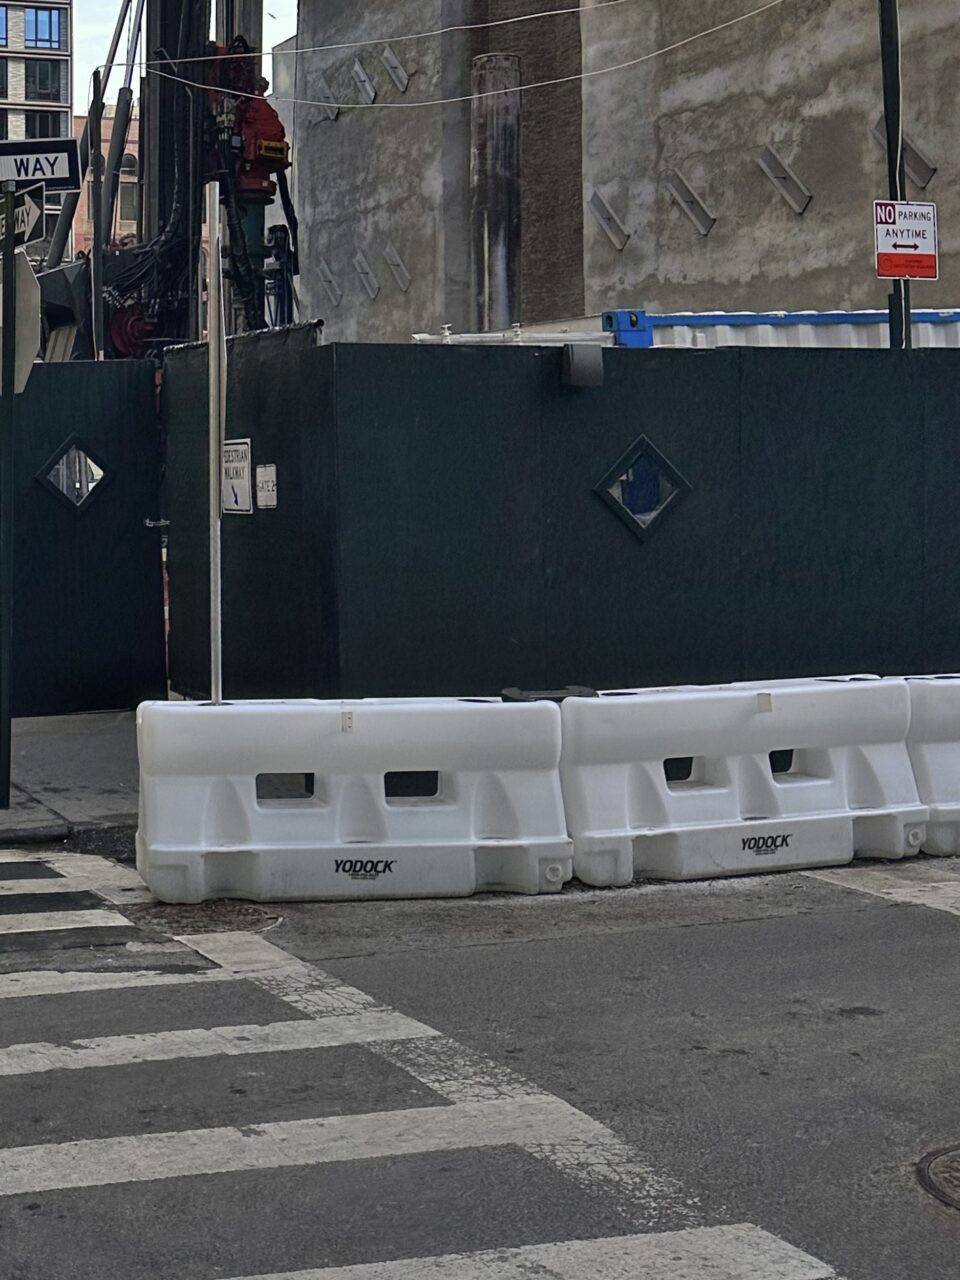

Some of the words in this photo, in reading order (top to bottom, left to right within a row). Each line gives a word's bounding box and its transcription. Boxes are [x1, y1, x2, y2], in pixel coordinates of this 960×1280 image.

[14, 156, 59, 177] WAY
[877, 205, 894, 223] NO
[898, 210, 932, 221] PARKING
[885, 229, 928, 239] ANYTIME
[223, 448, 248, 463] EDESTRIAN
[742, 834, 790, 851] YODOCK
[335, 859, 394, 873] YODOCK
